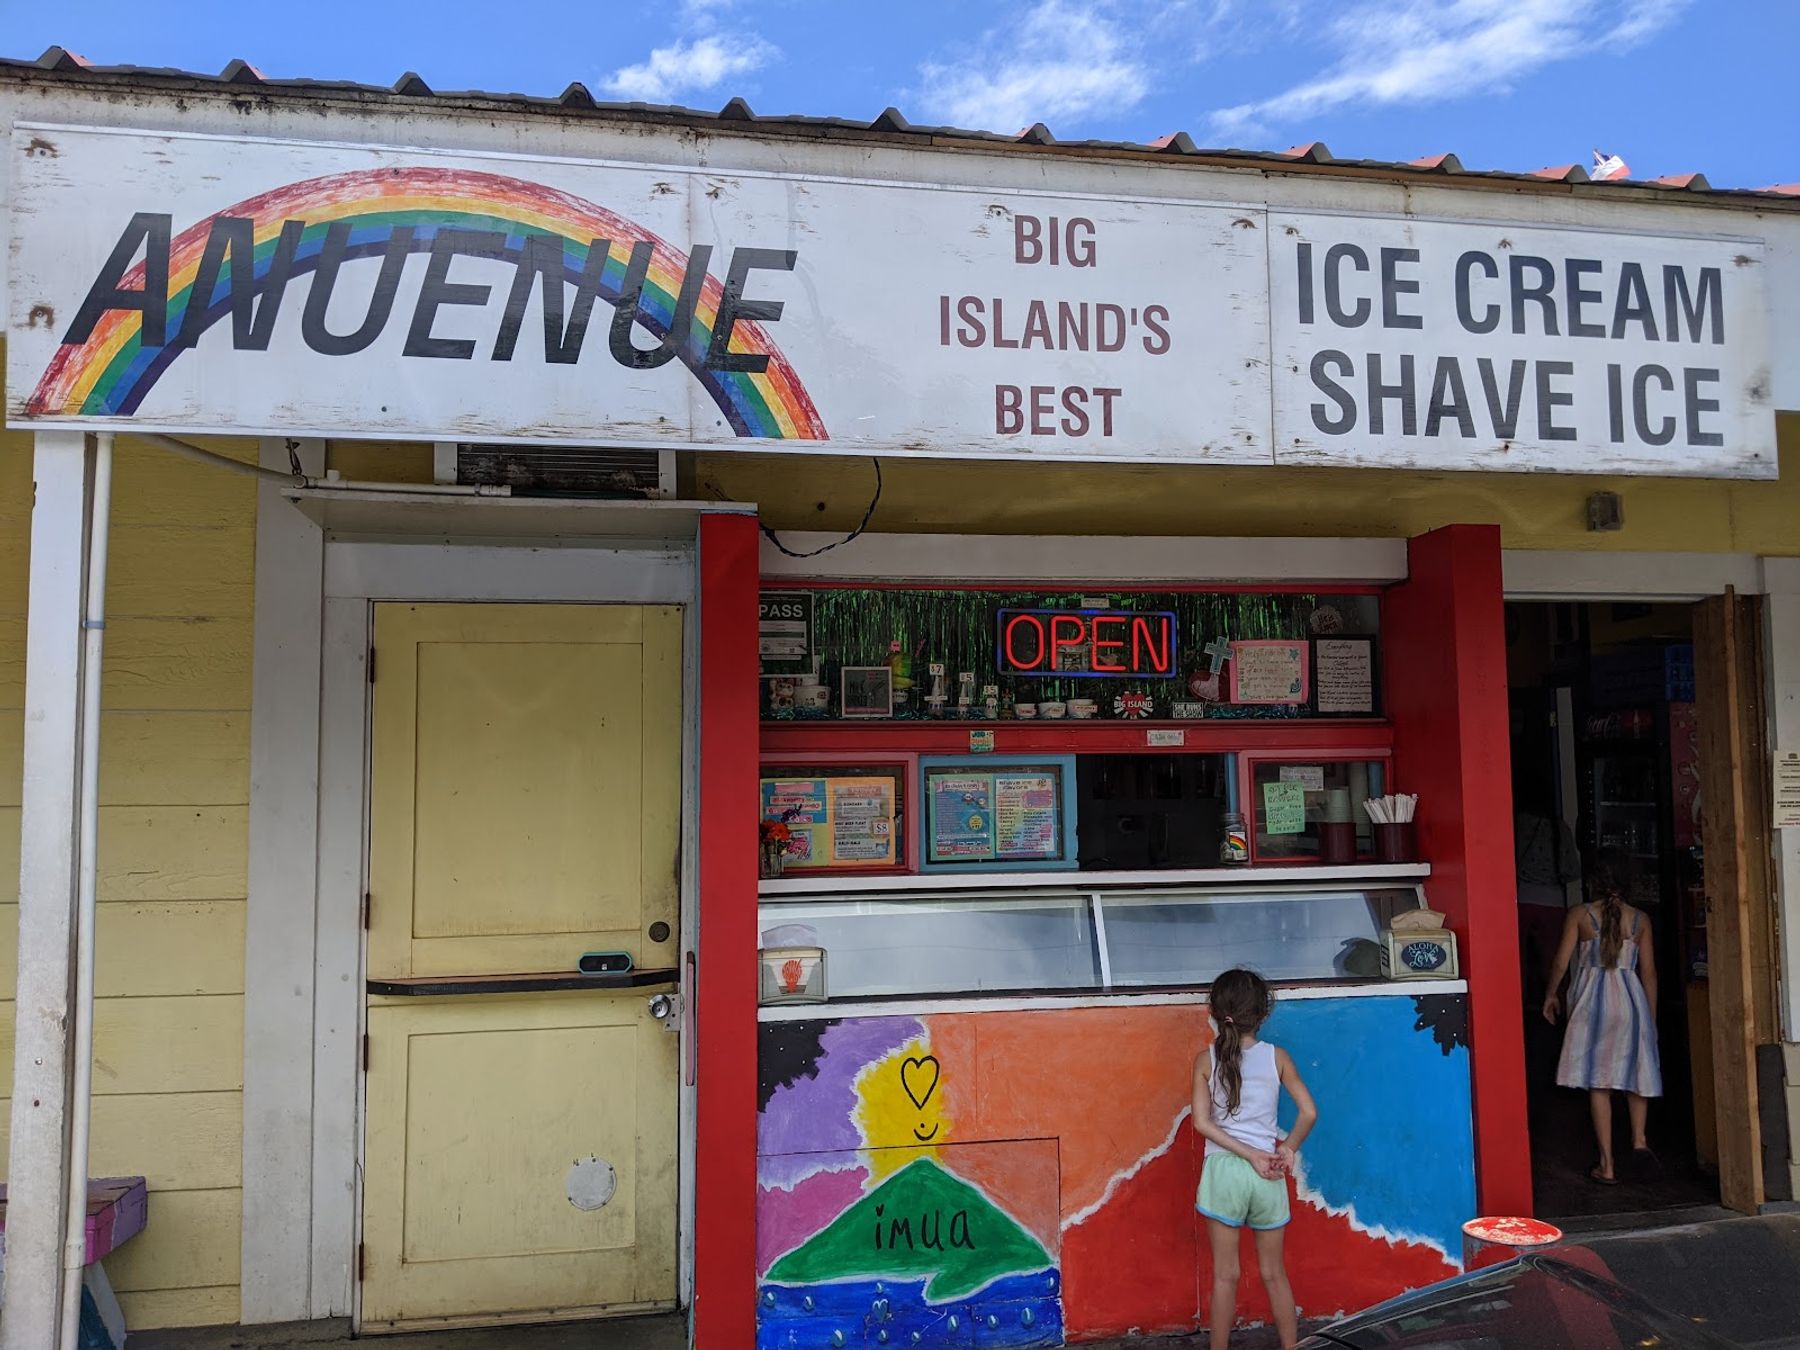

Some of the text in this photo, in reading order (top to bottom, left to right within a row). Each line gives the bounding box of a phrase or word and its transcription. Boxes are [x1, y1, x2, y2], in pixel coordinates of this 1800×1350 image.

[1014, 214, 1097, 268] BIG
[61, 211, 798, 374] ANUENUE
[1297, 242, 1725, 345] ICE CREAM
[940, 295, 1172, 355] ISLAND'S
[995, 384, 1122, 438] BEST
[1310, 349, 1724, 447] SHAVE ICE
[759, 603, 804, 618] PASS
[1004, 614, 1169, 672] OPEN
[1113, 700, 1154, 708] BIG ISLAND
[876, 823, 889, 833] $8
[1408, 942, 1439, 953] ALOHA
[875, 1203, 976, 1251] imua
